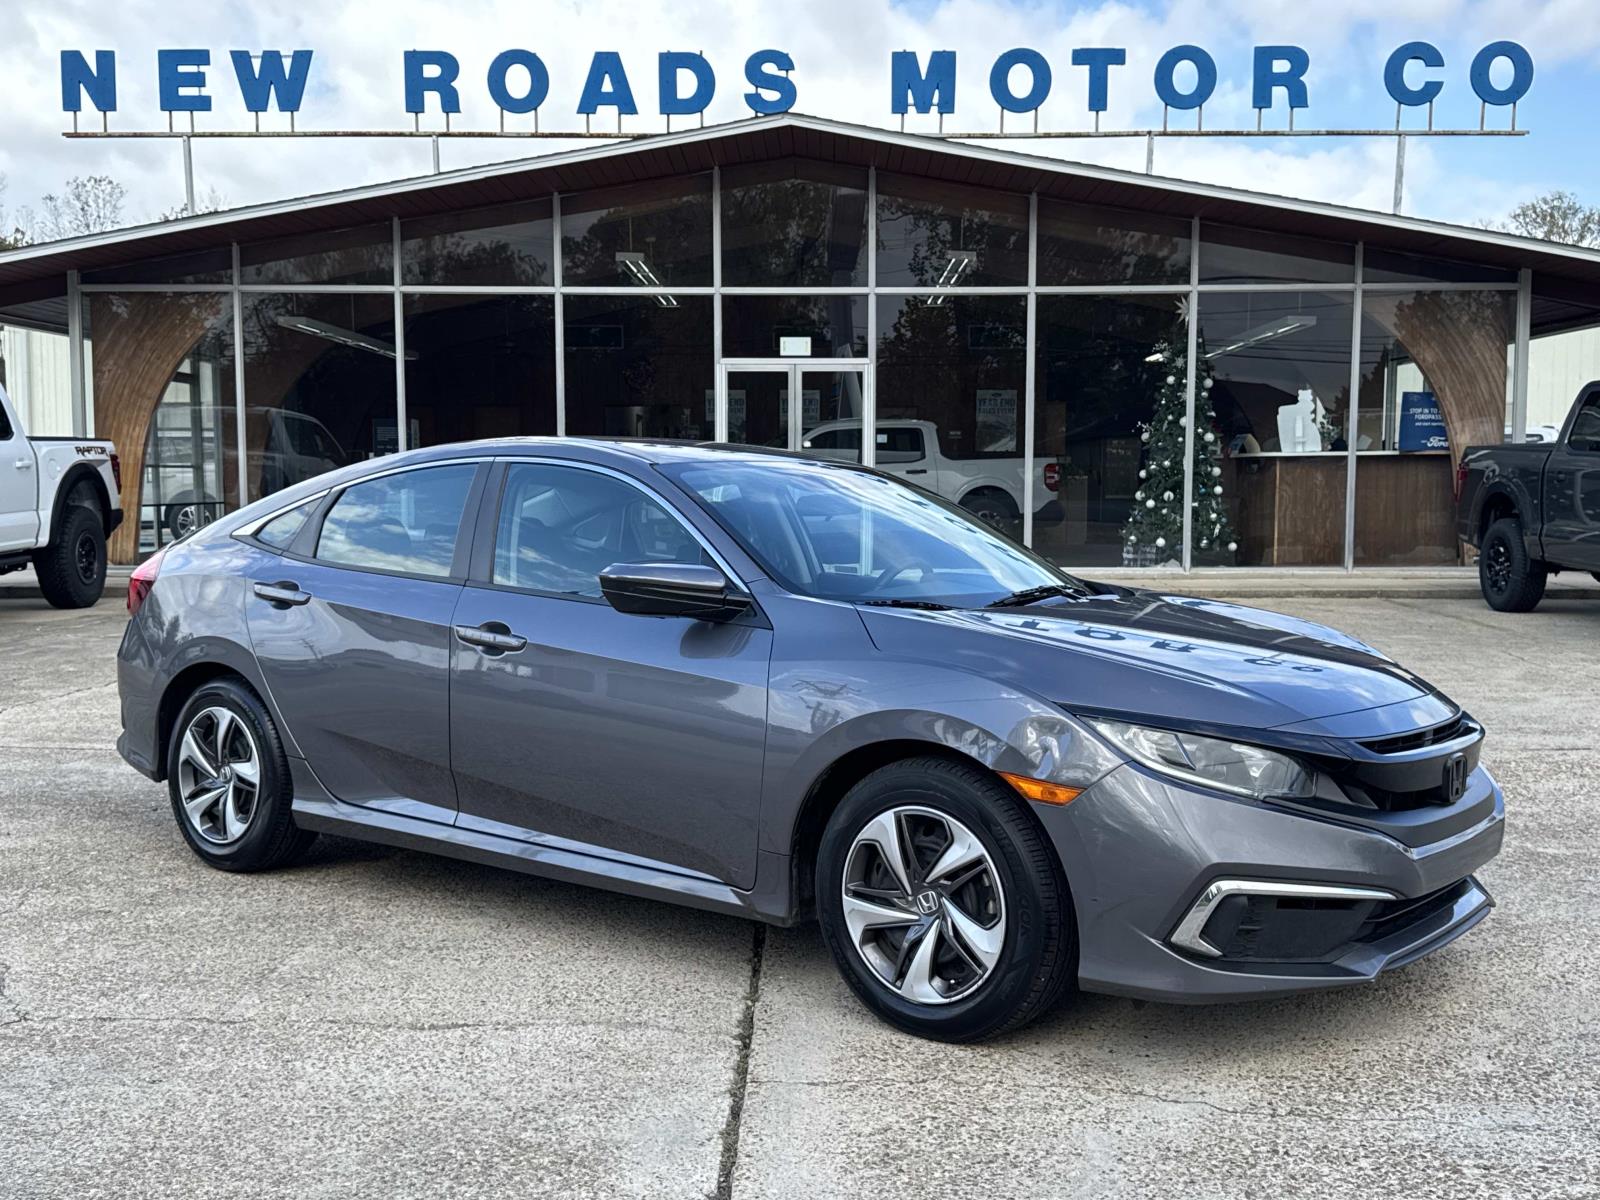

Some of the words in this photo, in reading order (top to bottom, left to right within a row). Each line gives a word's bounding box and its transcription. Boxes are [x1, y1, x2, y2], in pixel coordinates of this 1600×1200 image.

[61, 50, 313, 113] NEW
[404, 49, 797, 115] ROADS
[892, 45, 1310, 115] MOTOR
[1383, 41, 1534, 106] CO
[74, 446, 109, 457] RAPTOR
